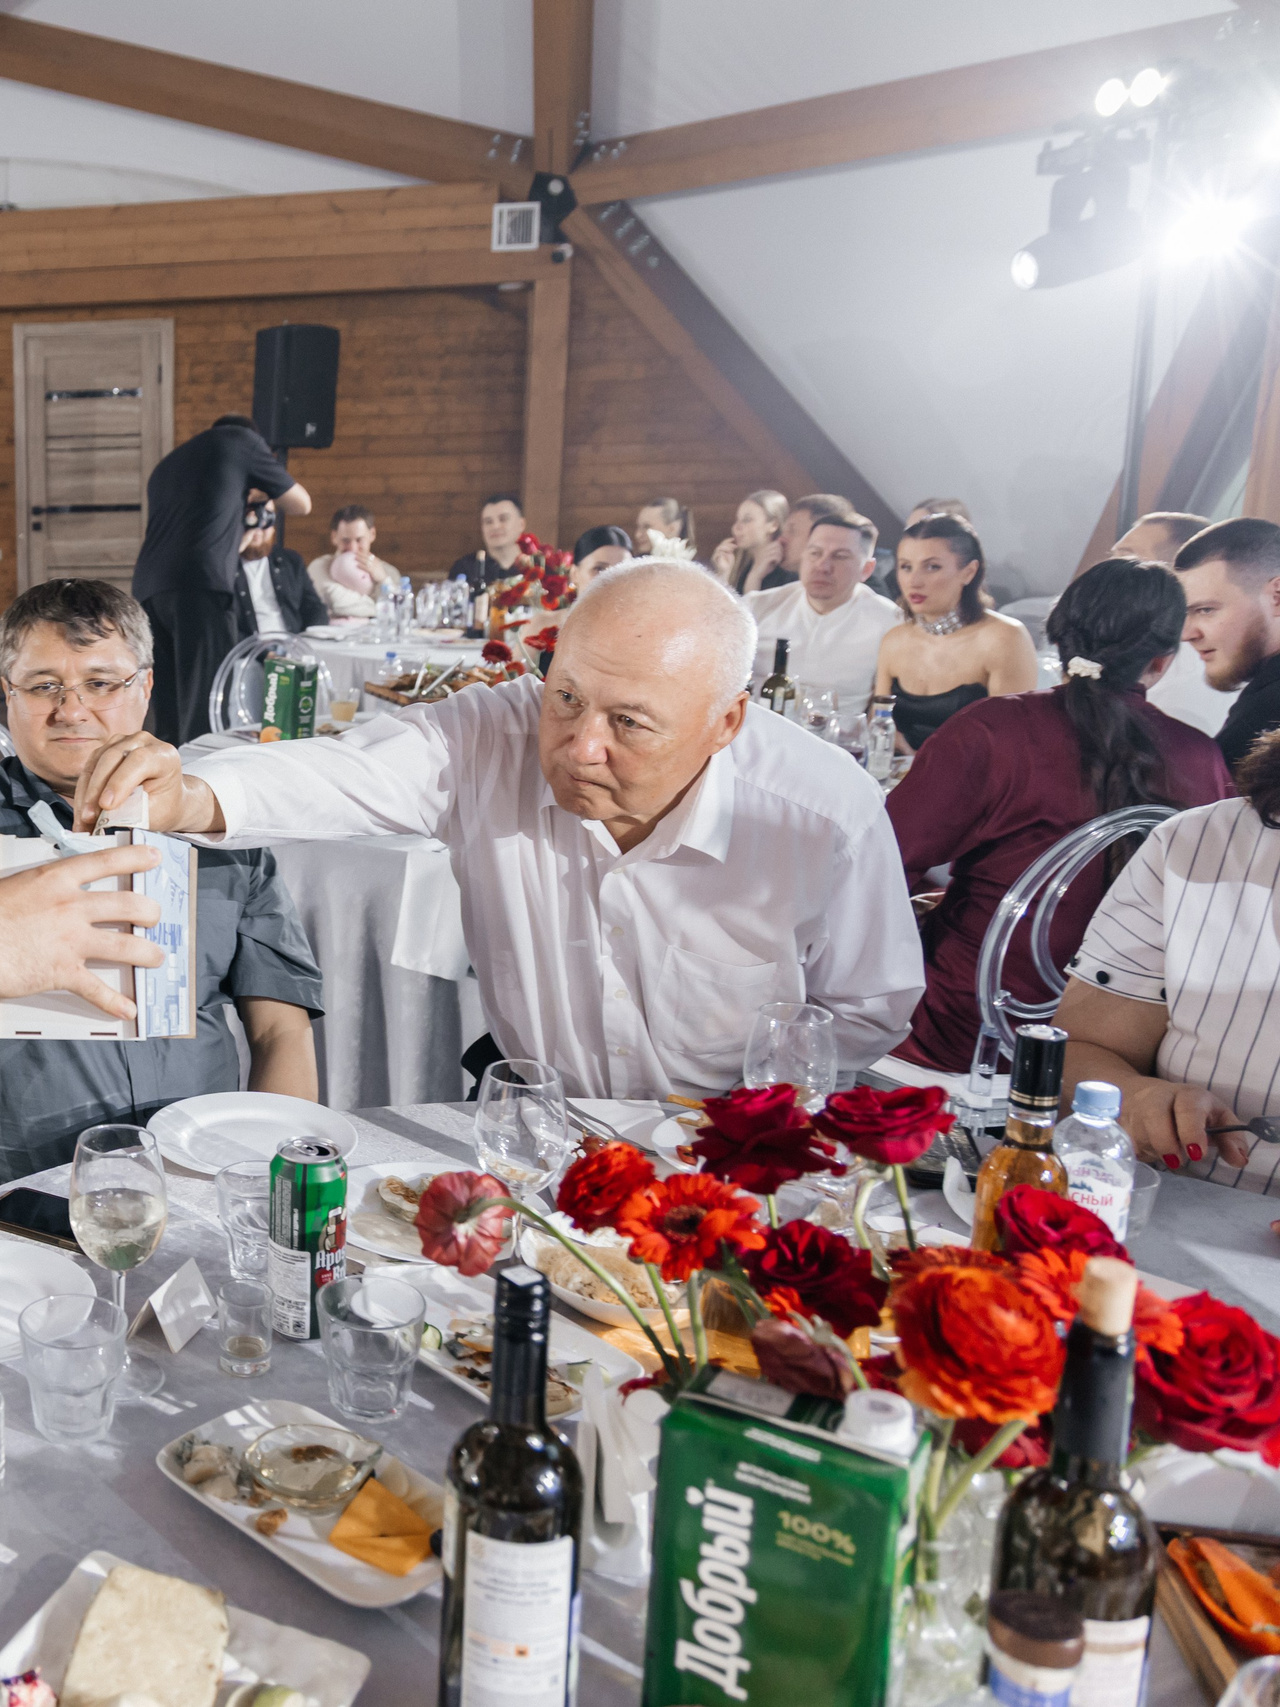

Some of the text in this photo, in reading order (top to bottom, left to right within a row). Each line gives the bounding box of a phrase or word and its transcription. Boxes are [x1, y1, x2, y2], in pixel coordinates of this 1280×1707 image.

[264, 672, 278, 723] Добрый
[1071, 1192, 1113, 1206] СНЫЙ
[315, 1249, 346, 1271] Apos
[777, 1510, 856, 1555] 100%
[674, 1485, 757, 1701] Добрый
